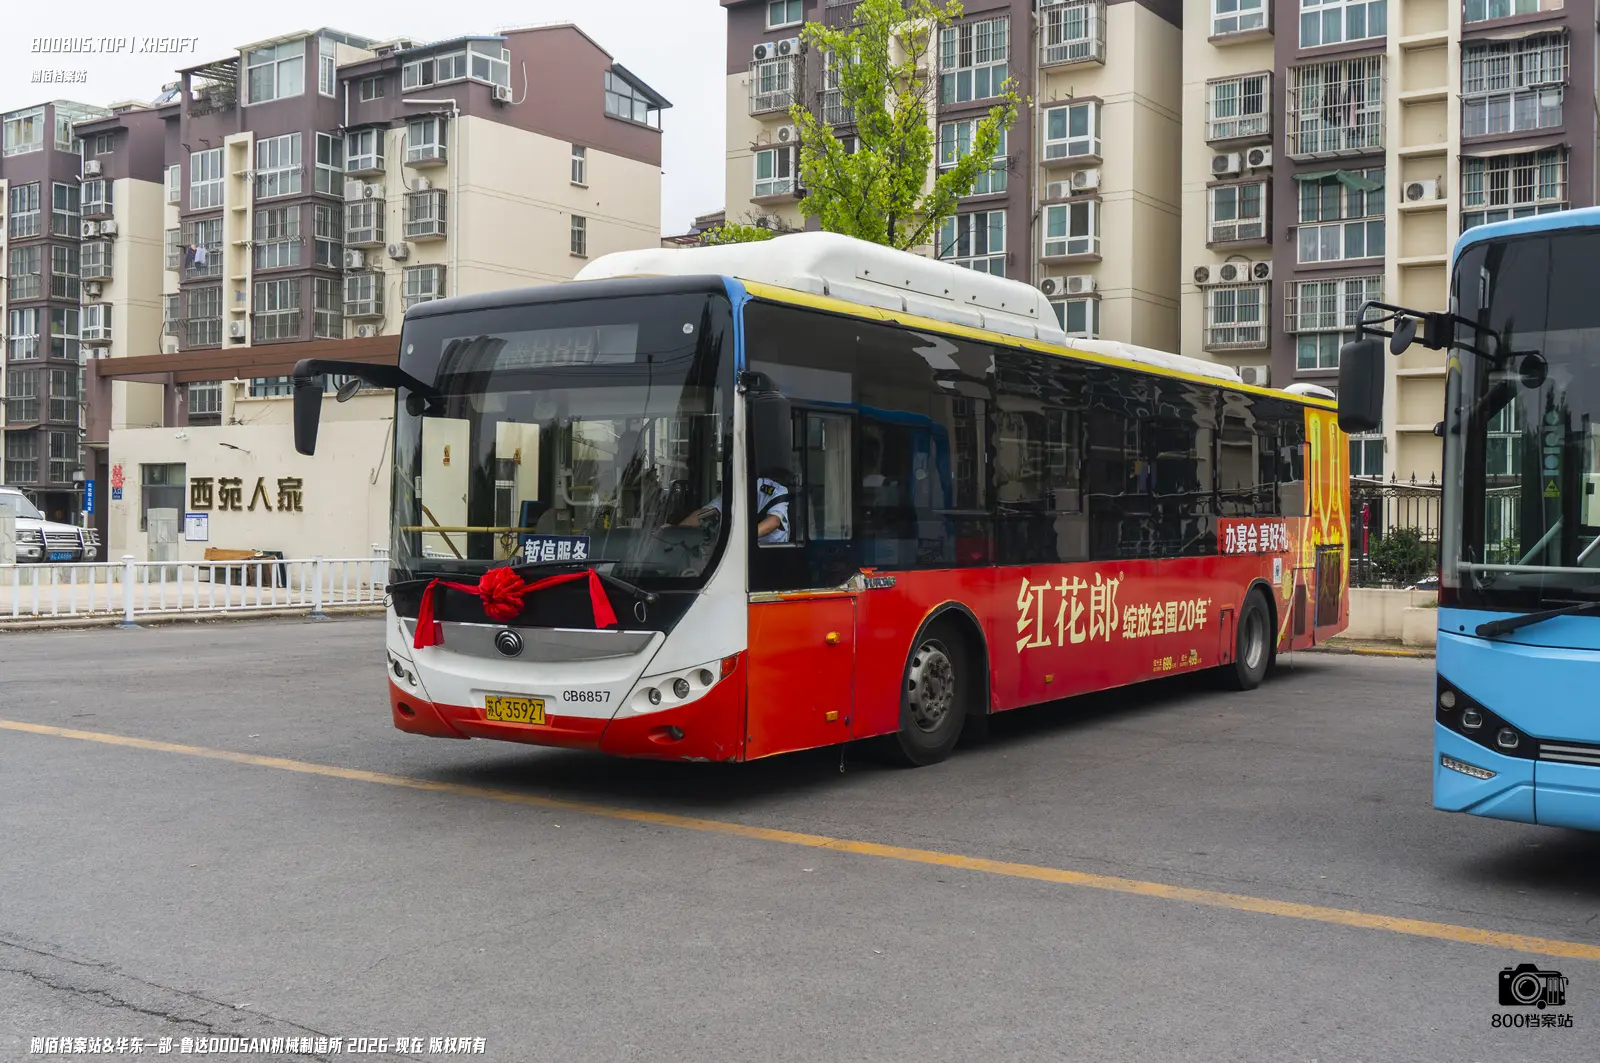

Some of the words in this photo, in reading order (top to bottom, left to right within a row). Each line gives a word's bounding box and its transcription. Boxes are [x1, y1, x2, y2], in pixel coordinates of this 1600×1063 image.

[190, 476, 304, 512] 西苑人家
[525, 538, 588, 563] 暂停服务
[1225, 523, 1258, 554] 办宴会
[1260, 522, 1289, 551] 享好礼
[1016, 572, 1120, 654] 红花郎
[563, 690, 611, 703] CB6857
